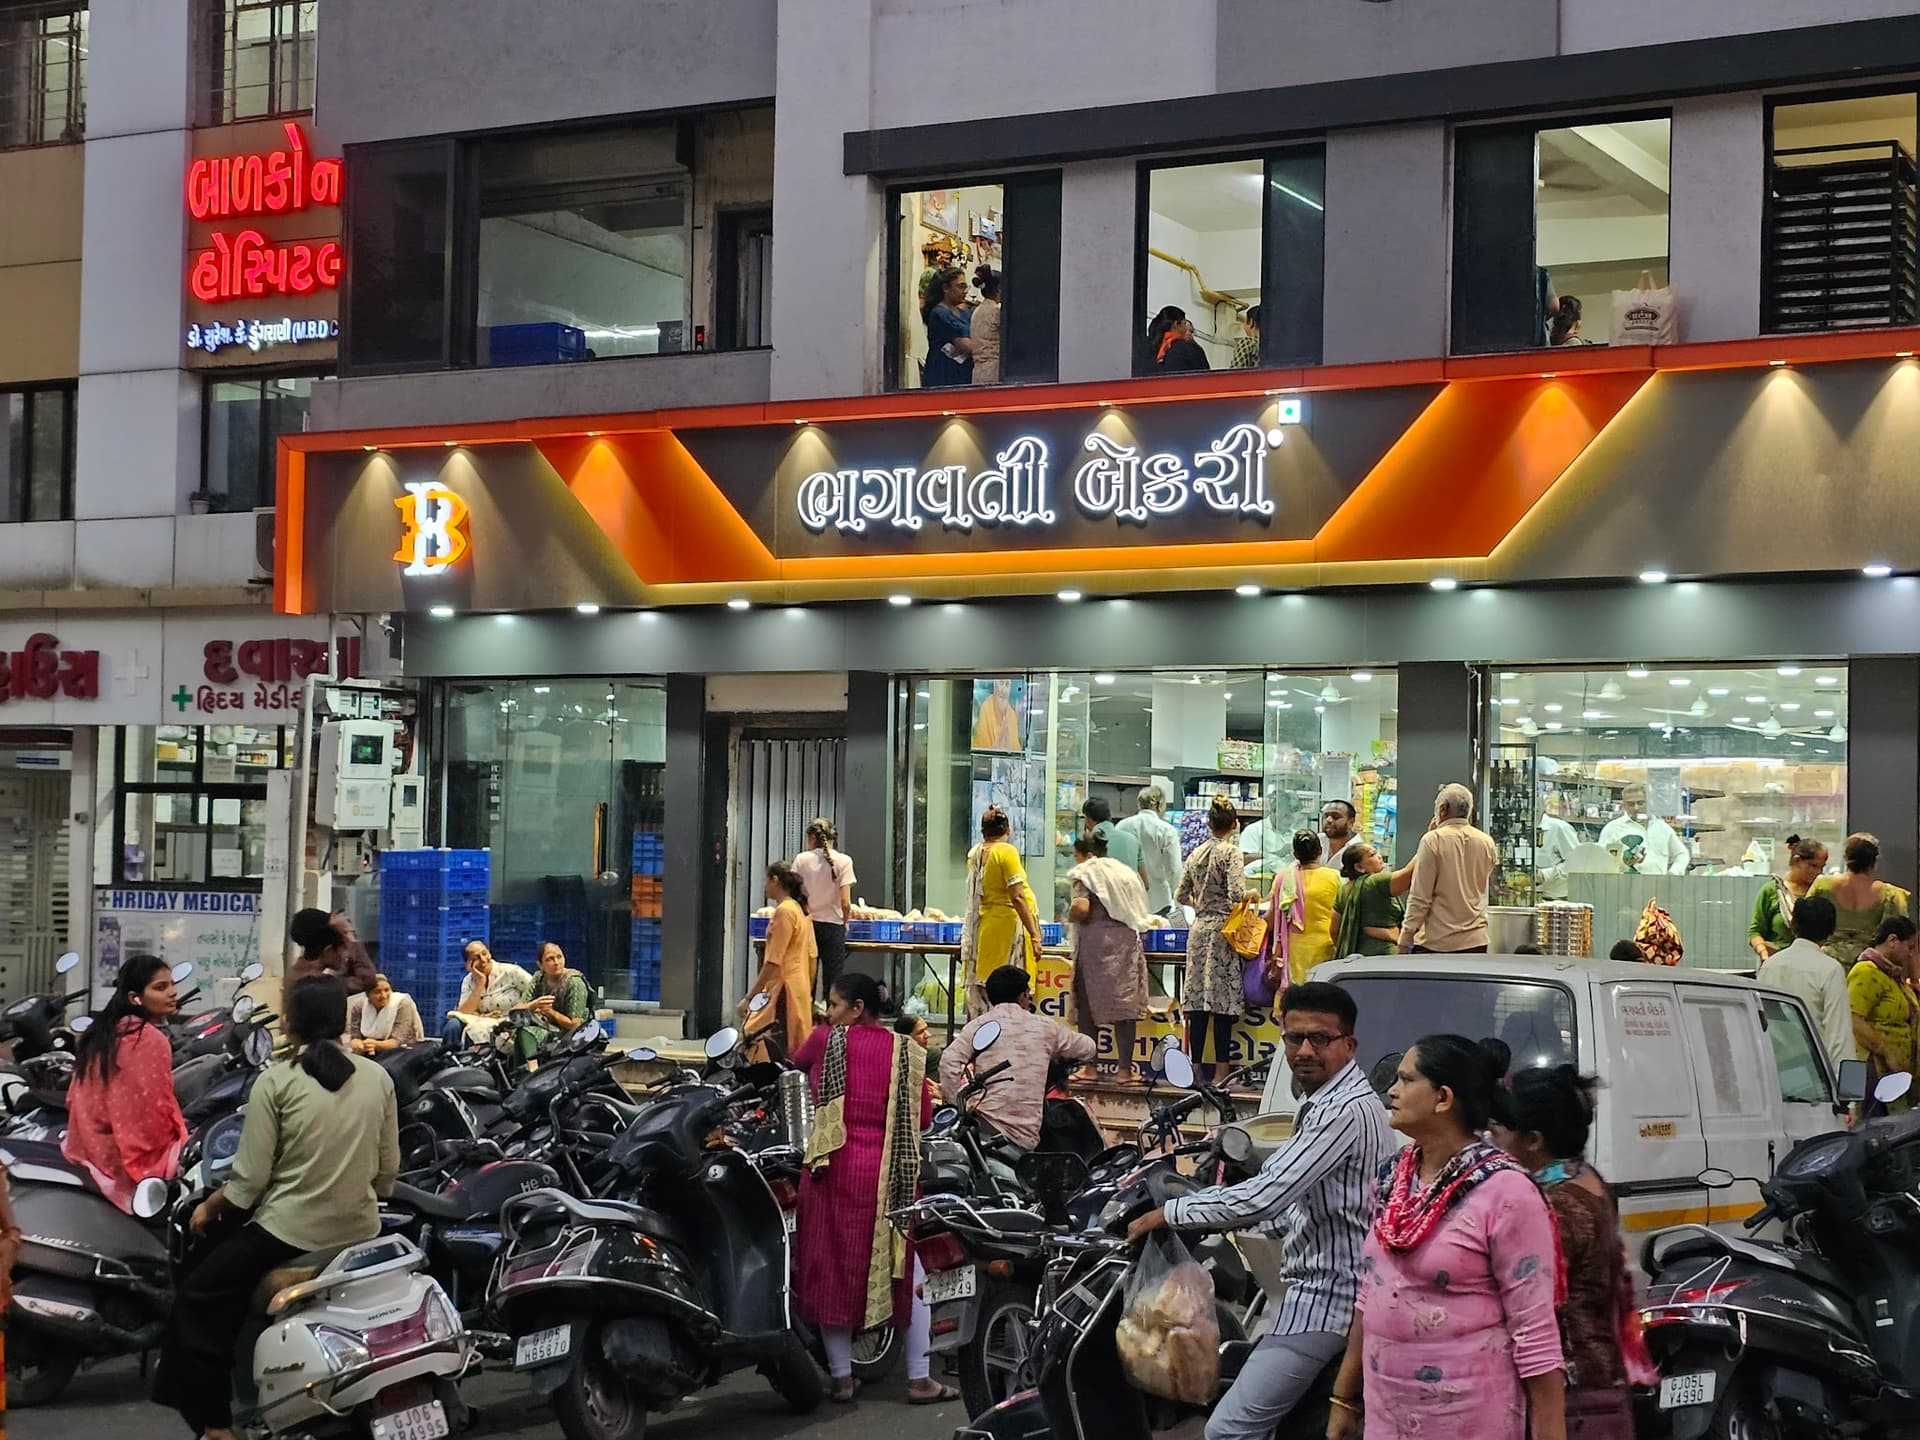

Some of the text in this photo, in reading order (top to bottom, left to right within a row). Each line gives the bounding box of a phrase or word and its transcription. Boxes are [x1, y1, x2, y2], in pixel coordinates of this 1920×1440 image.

[797, 423, 1277, 533] ભગવતી બેકરી
[112, 891, 179, 910] HRIDAY
[520, 1175, 551, 1194] Heo
[368, 1307, 403, 1321] HONDA
[1671, 1375, 1704, 1390] GJ05L
[393, 1405, 431, 1429] GJ06
